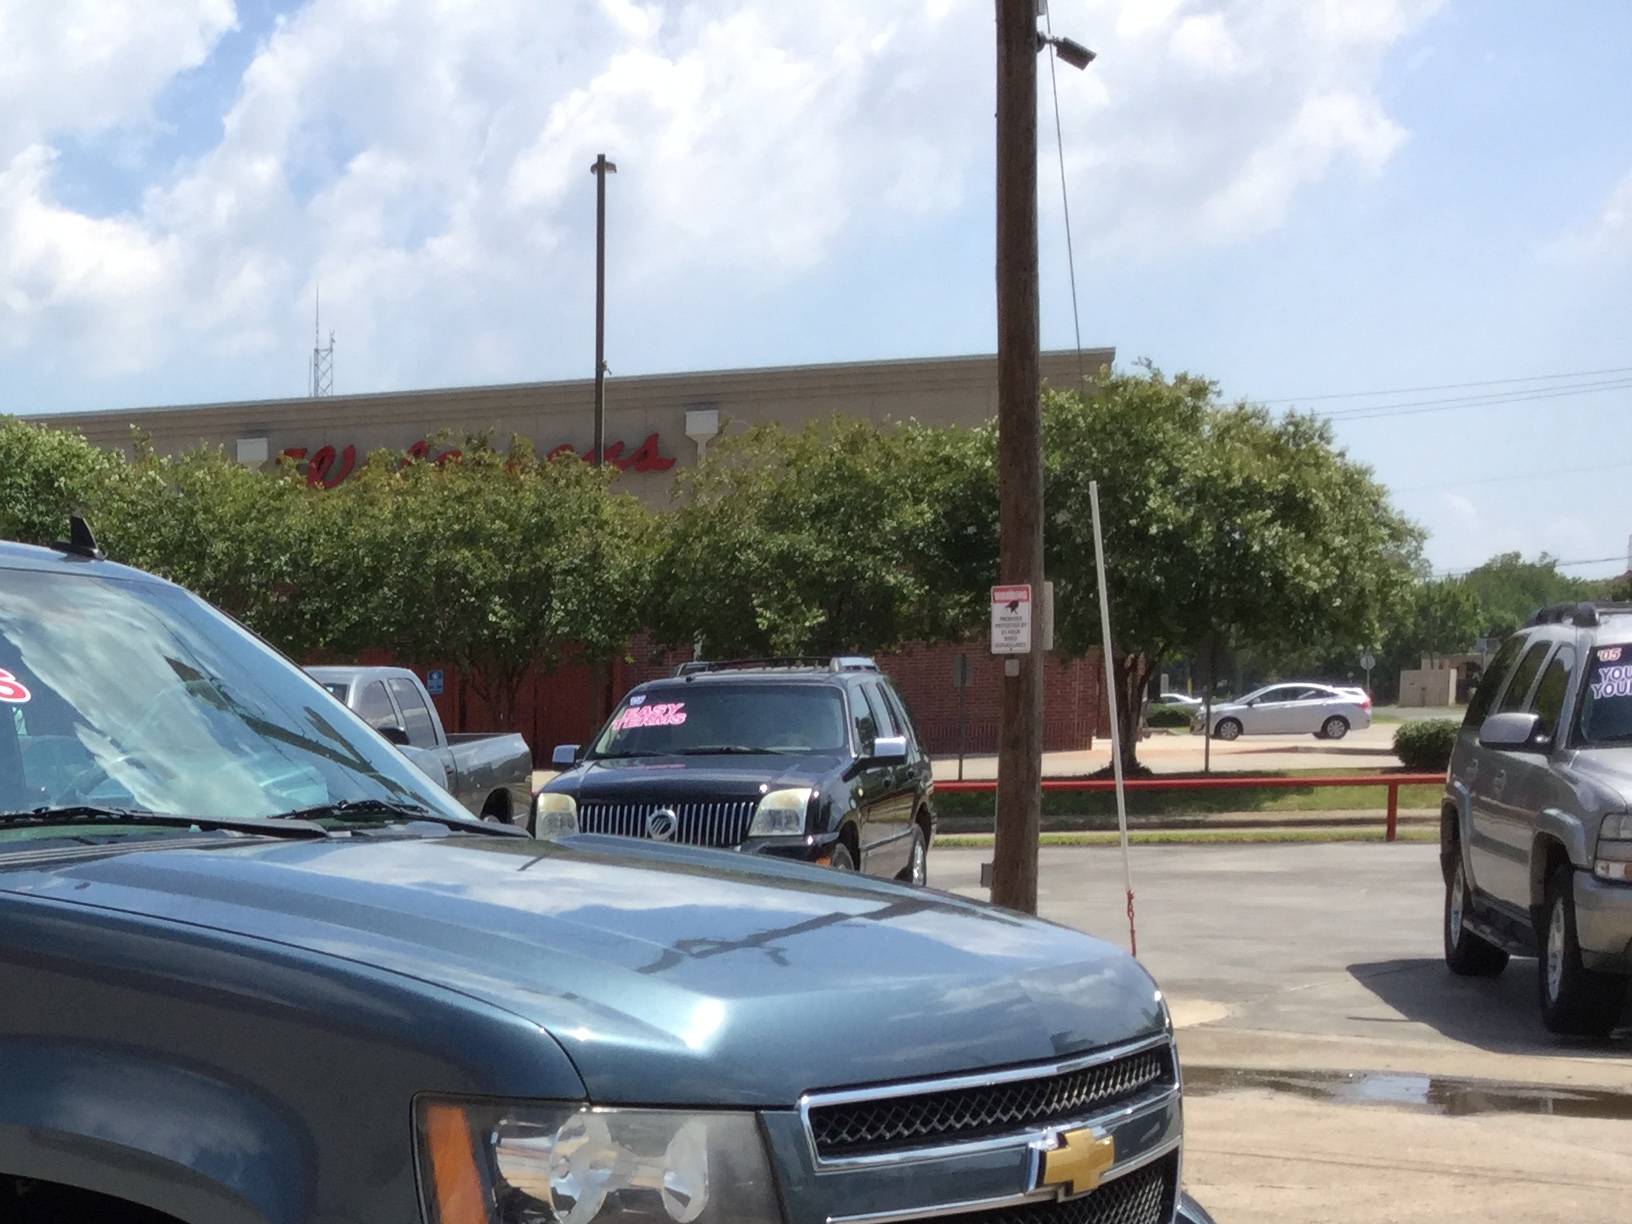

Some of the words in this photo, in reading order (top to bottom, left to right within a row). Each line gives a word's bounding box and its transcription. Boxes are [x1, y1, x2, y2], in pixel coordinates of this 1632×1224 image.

[1597, 647, 1622, 662] '05
[1591, 679, 1632, 700] YOU
[623, 702, 685, 718] EASY
[612, 712, 687, 731] TERMS
